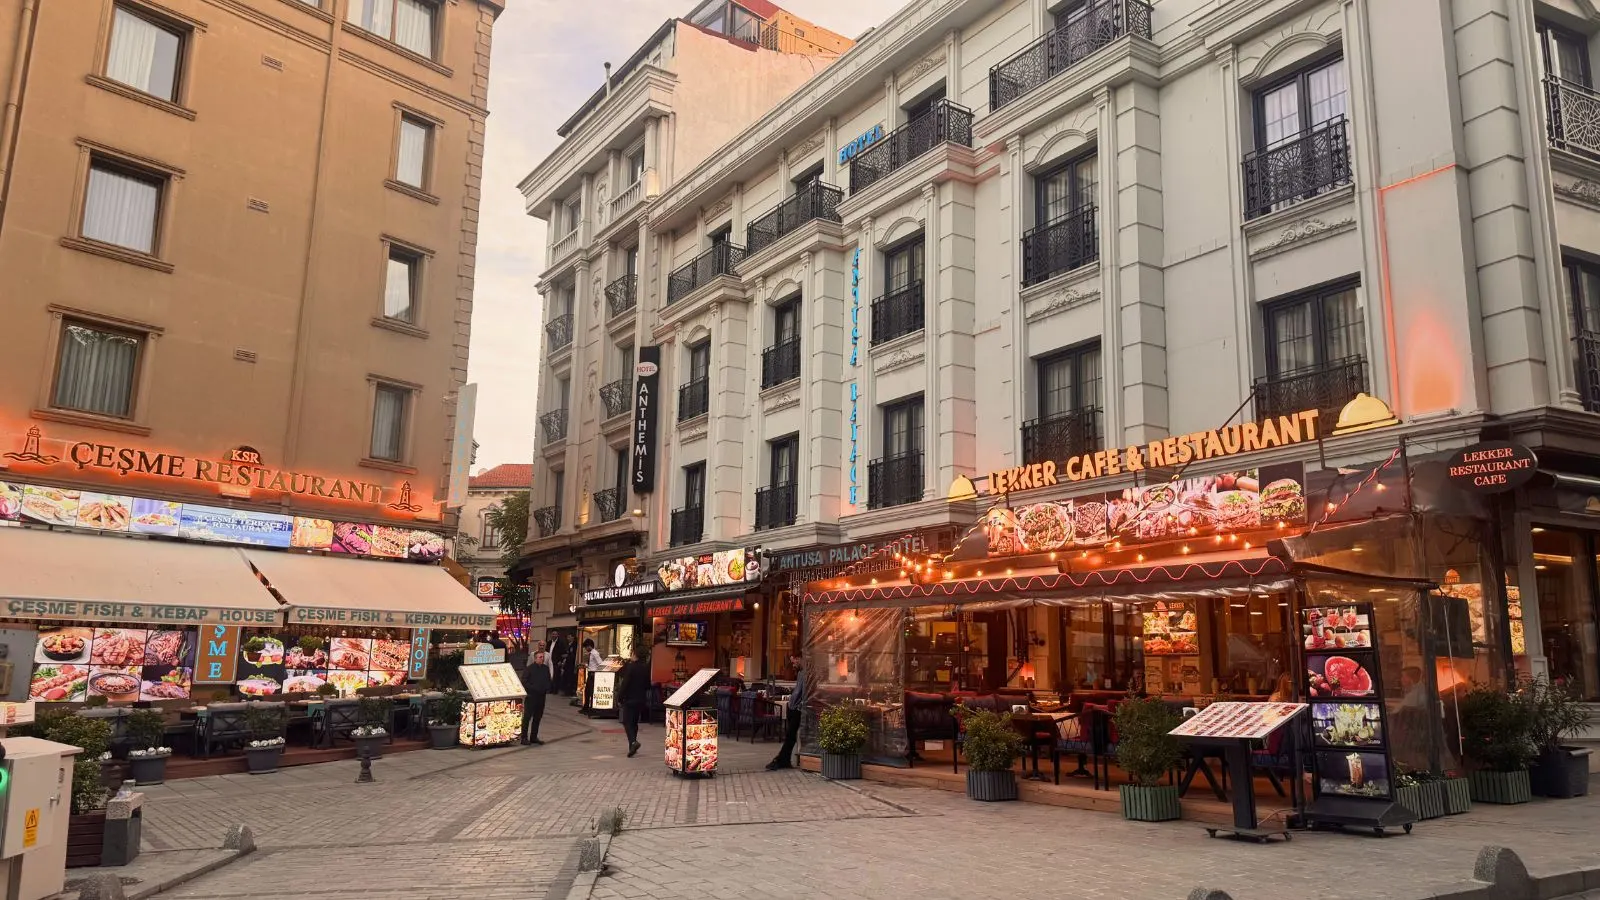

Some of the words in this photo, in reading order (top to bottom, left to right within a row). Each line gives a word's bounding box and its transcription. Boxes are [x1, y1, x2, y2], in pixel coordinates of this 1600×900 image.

[837, 124, 883, 165] HOTEL
[636, 365, 655, 373] HOTEL
[231, 449, 260, 464] KSR
[988, 460, 1057, 496] LEKKER
[1066, 447, 1121, 481] CAFE
[1126, 444, 1146, 471] &
[1148, 409, 1319, 467] RESTAURANT
[1464, 447, 1513, 463] LEKKER
[70, 441, 185, 477] ÇEŞME
[195, 458, 382, 503] RESTAURANT
[1450, 459, 1530, 476] RESTAURANT
[1474, 474, 1507, 486] CAFE
[780, 552, 824, 569] ANTUSA
[829, 544, 875, 563] PALACE
[584, 591, 604, 601] SULTAN
[633, 583, 654, 595] HAMAM
[7, 601, 77, 616] ÇEŞME
[131, 606, 144, 618] &
[150, 607, 209, 620] KEBAP
[219, 610, 275, 623] HOUSE
[297, 608, 346, 621] ÇEŞME
[385, 612, 395, 623] &
[404, 613, 447, 626] KEBAP
[450, 614, 492, 626] HOUSE
[674, 604, 688, 614] CAFE
